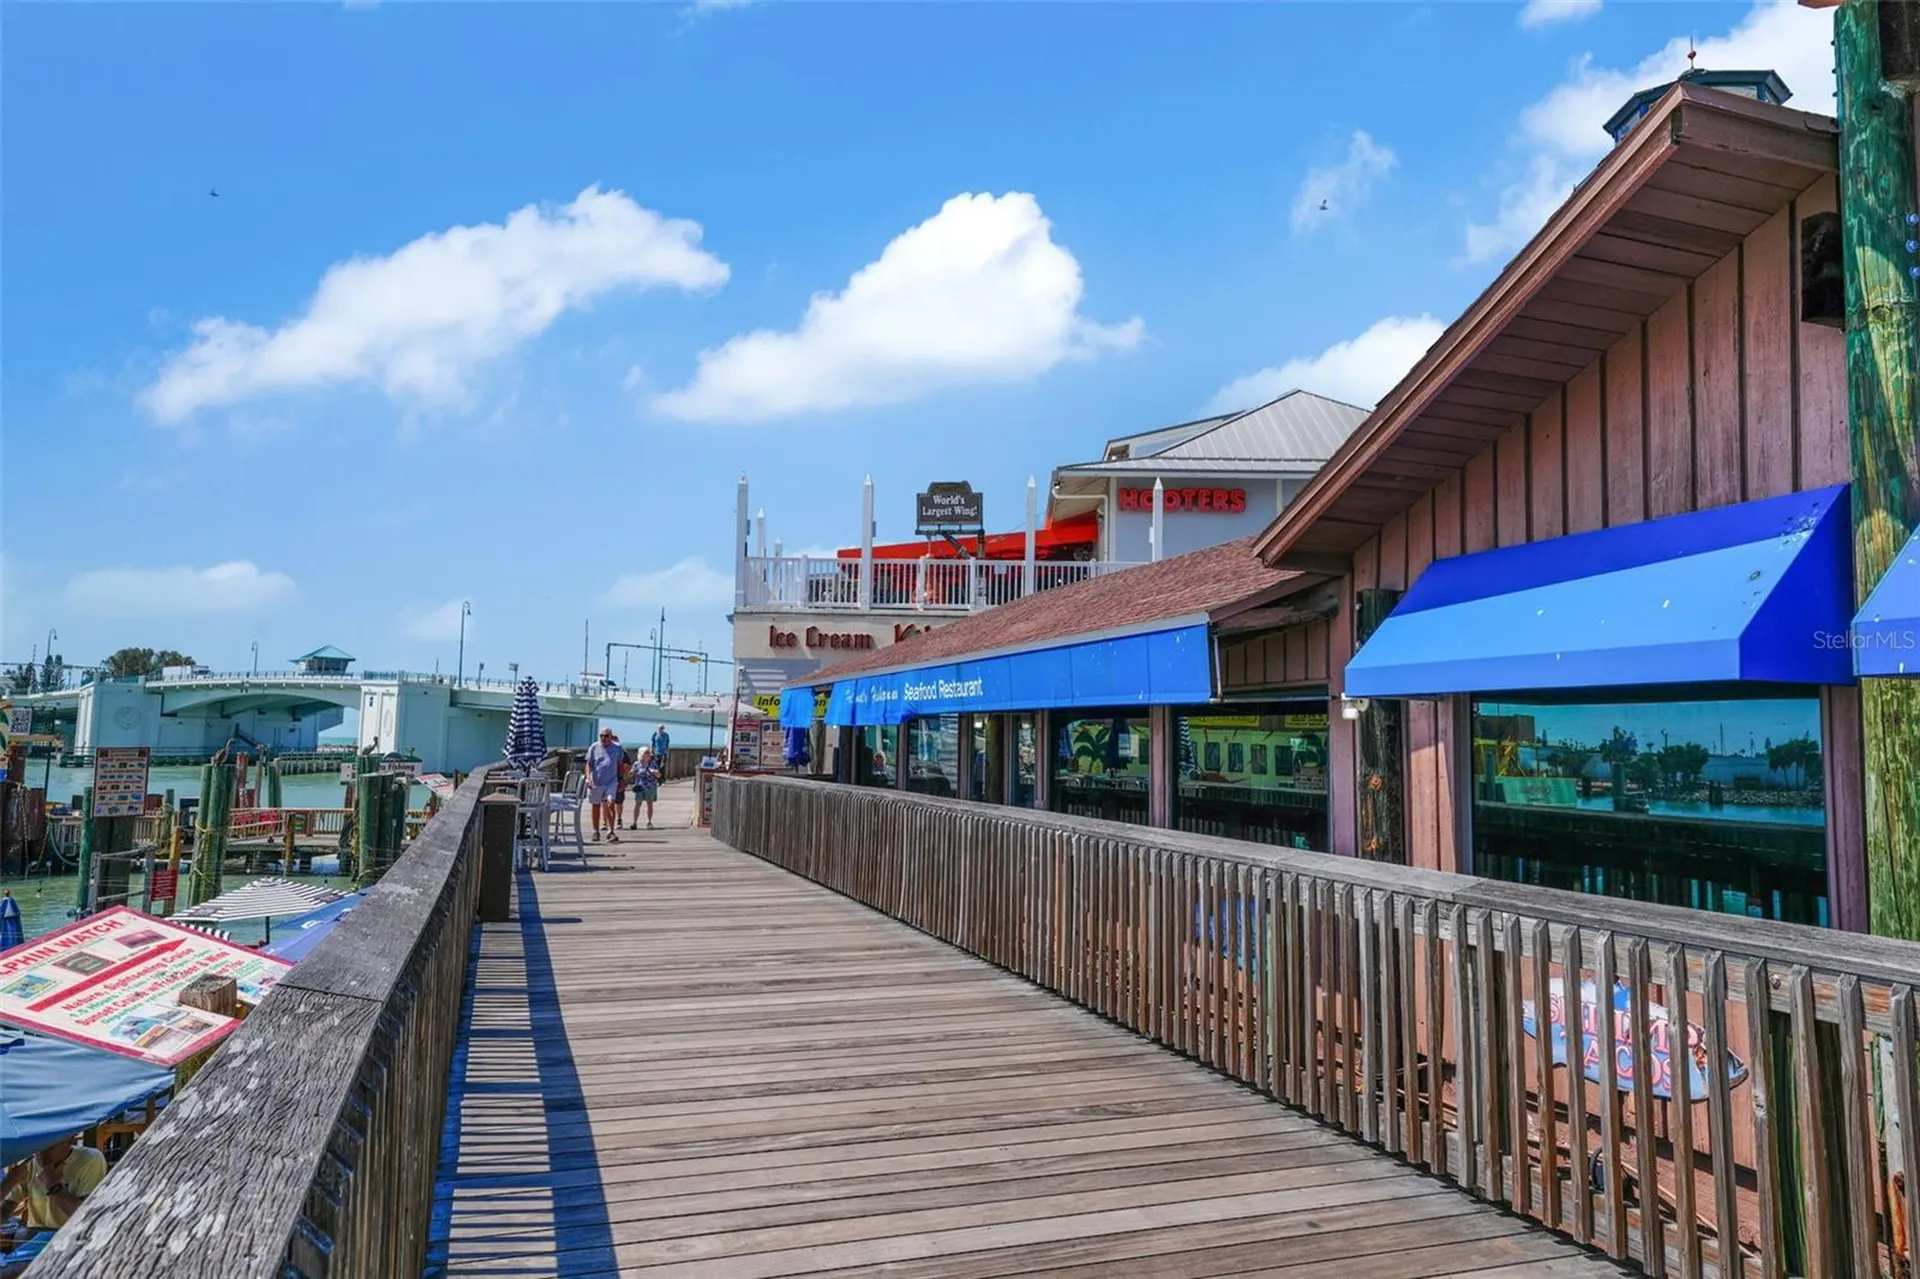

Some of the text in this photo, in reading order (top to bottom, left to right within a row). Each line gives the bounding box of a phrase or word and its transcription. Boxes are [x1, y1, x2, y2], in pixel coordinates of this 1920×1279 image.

[922, 506, 978, 517] Largest Wing!
[933, 495, 965, 505] World's
[1118, 487, 1247, 513] HOOTERS
[769, 624, 797, 649] Ice
[806, 625, 873, 650] Cream
[904, 680, 936, 701] Seafood
[938, 677, 984, 698] Restaurant
[54, 918, 124, 949] WATCH
